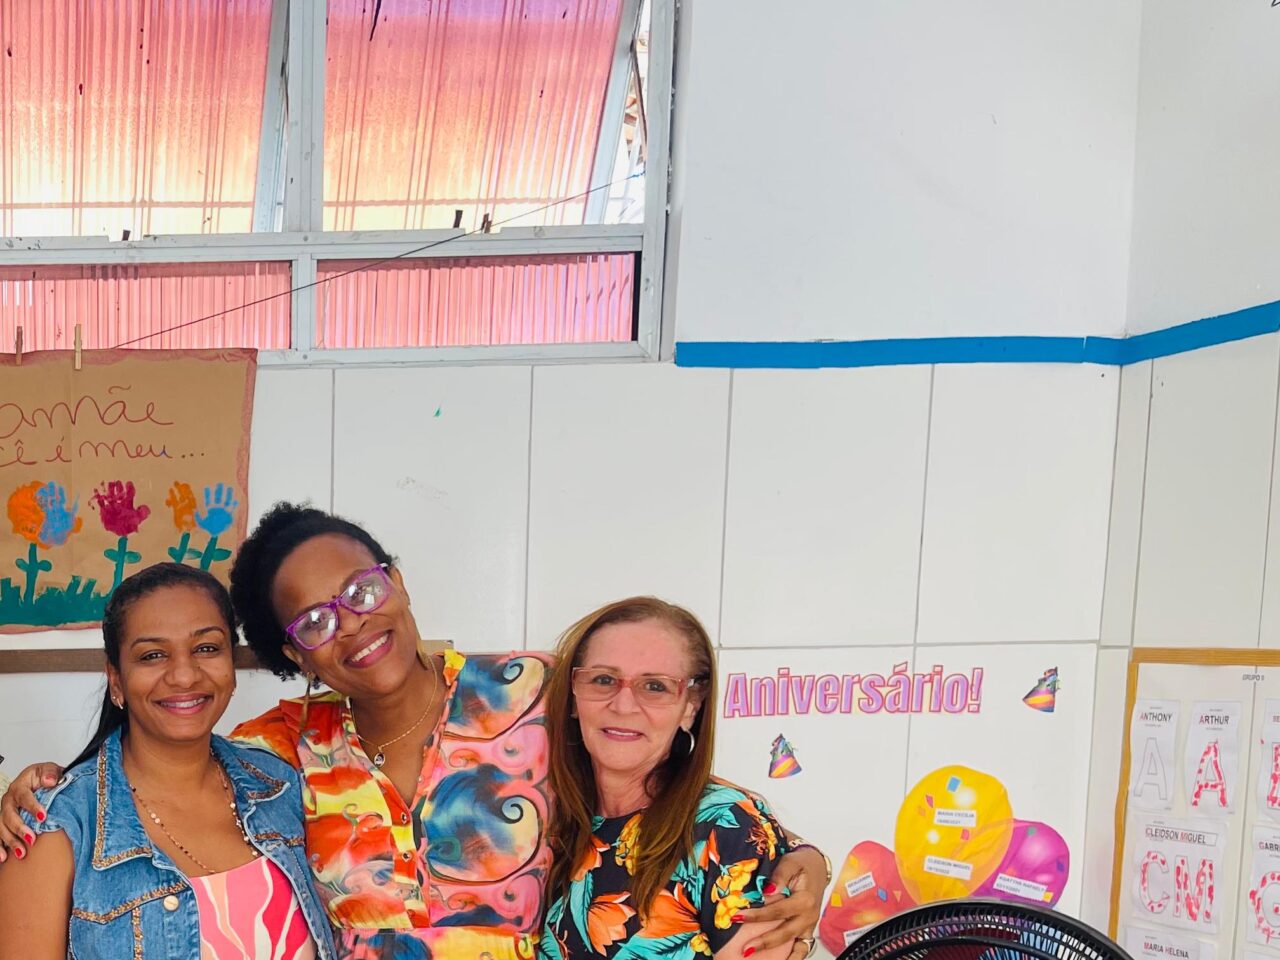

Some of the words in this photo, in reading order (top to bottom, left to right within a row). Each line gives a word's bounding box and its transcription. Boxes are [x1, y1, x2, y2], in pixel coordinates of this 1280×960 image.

[723, 661, 984, 718] Aniversário!
[1139, 712, 1173, 723] ANTHONY
[1198, 715, 1230, 726] ARTHUR
[1145, 827, 1179, 841] CLEIDSON
[1180, 831, 1207, 845] MIGUEL
[1143, 942, 1165, 953] MARIA
[1165, 947, 1190, 959] HELENA
